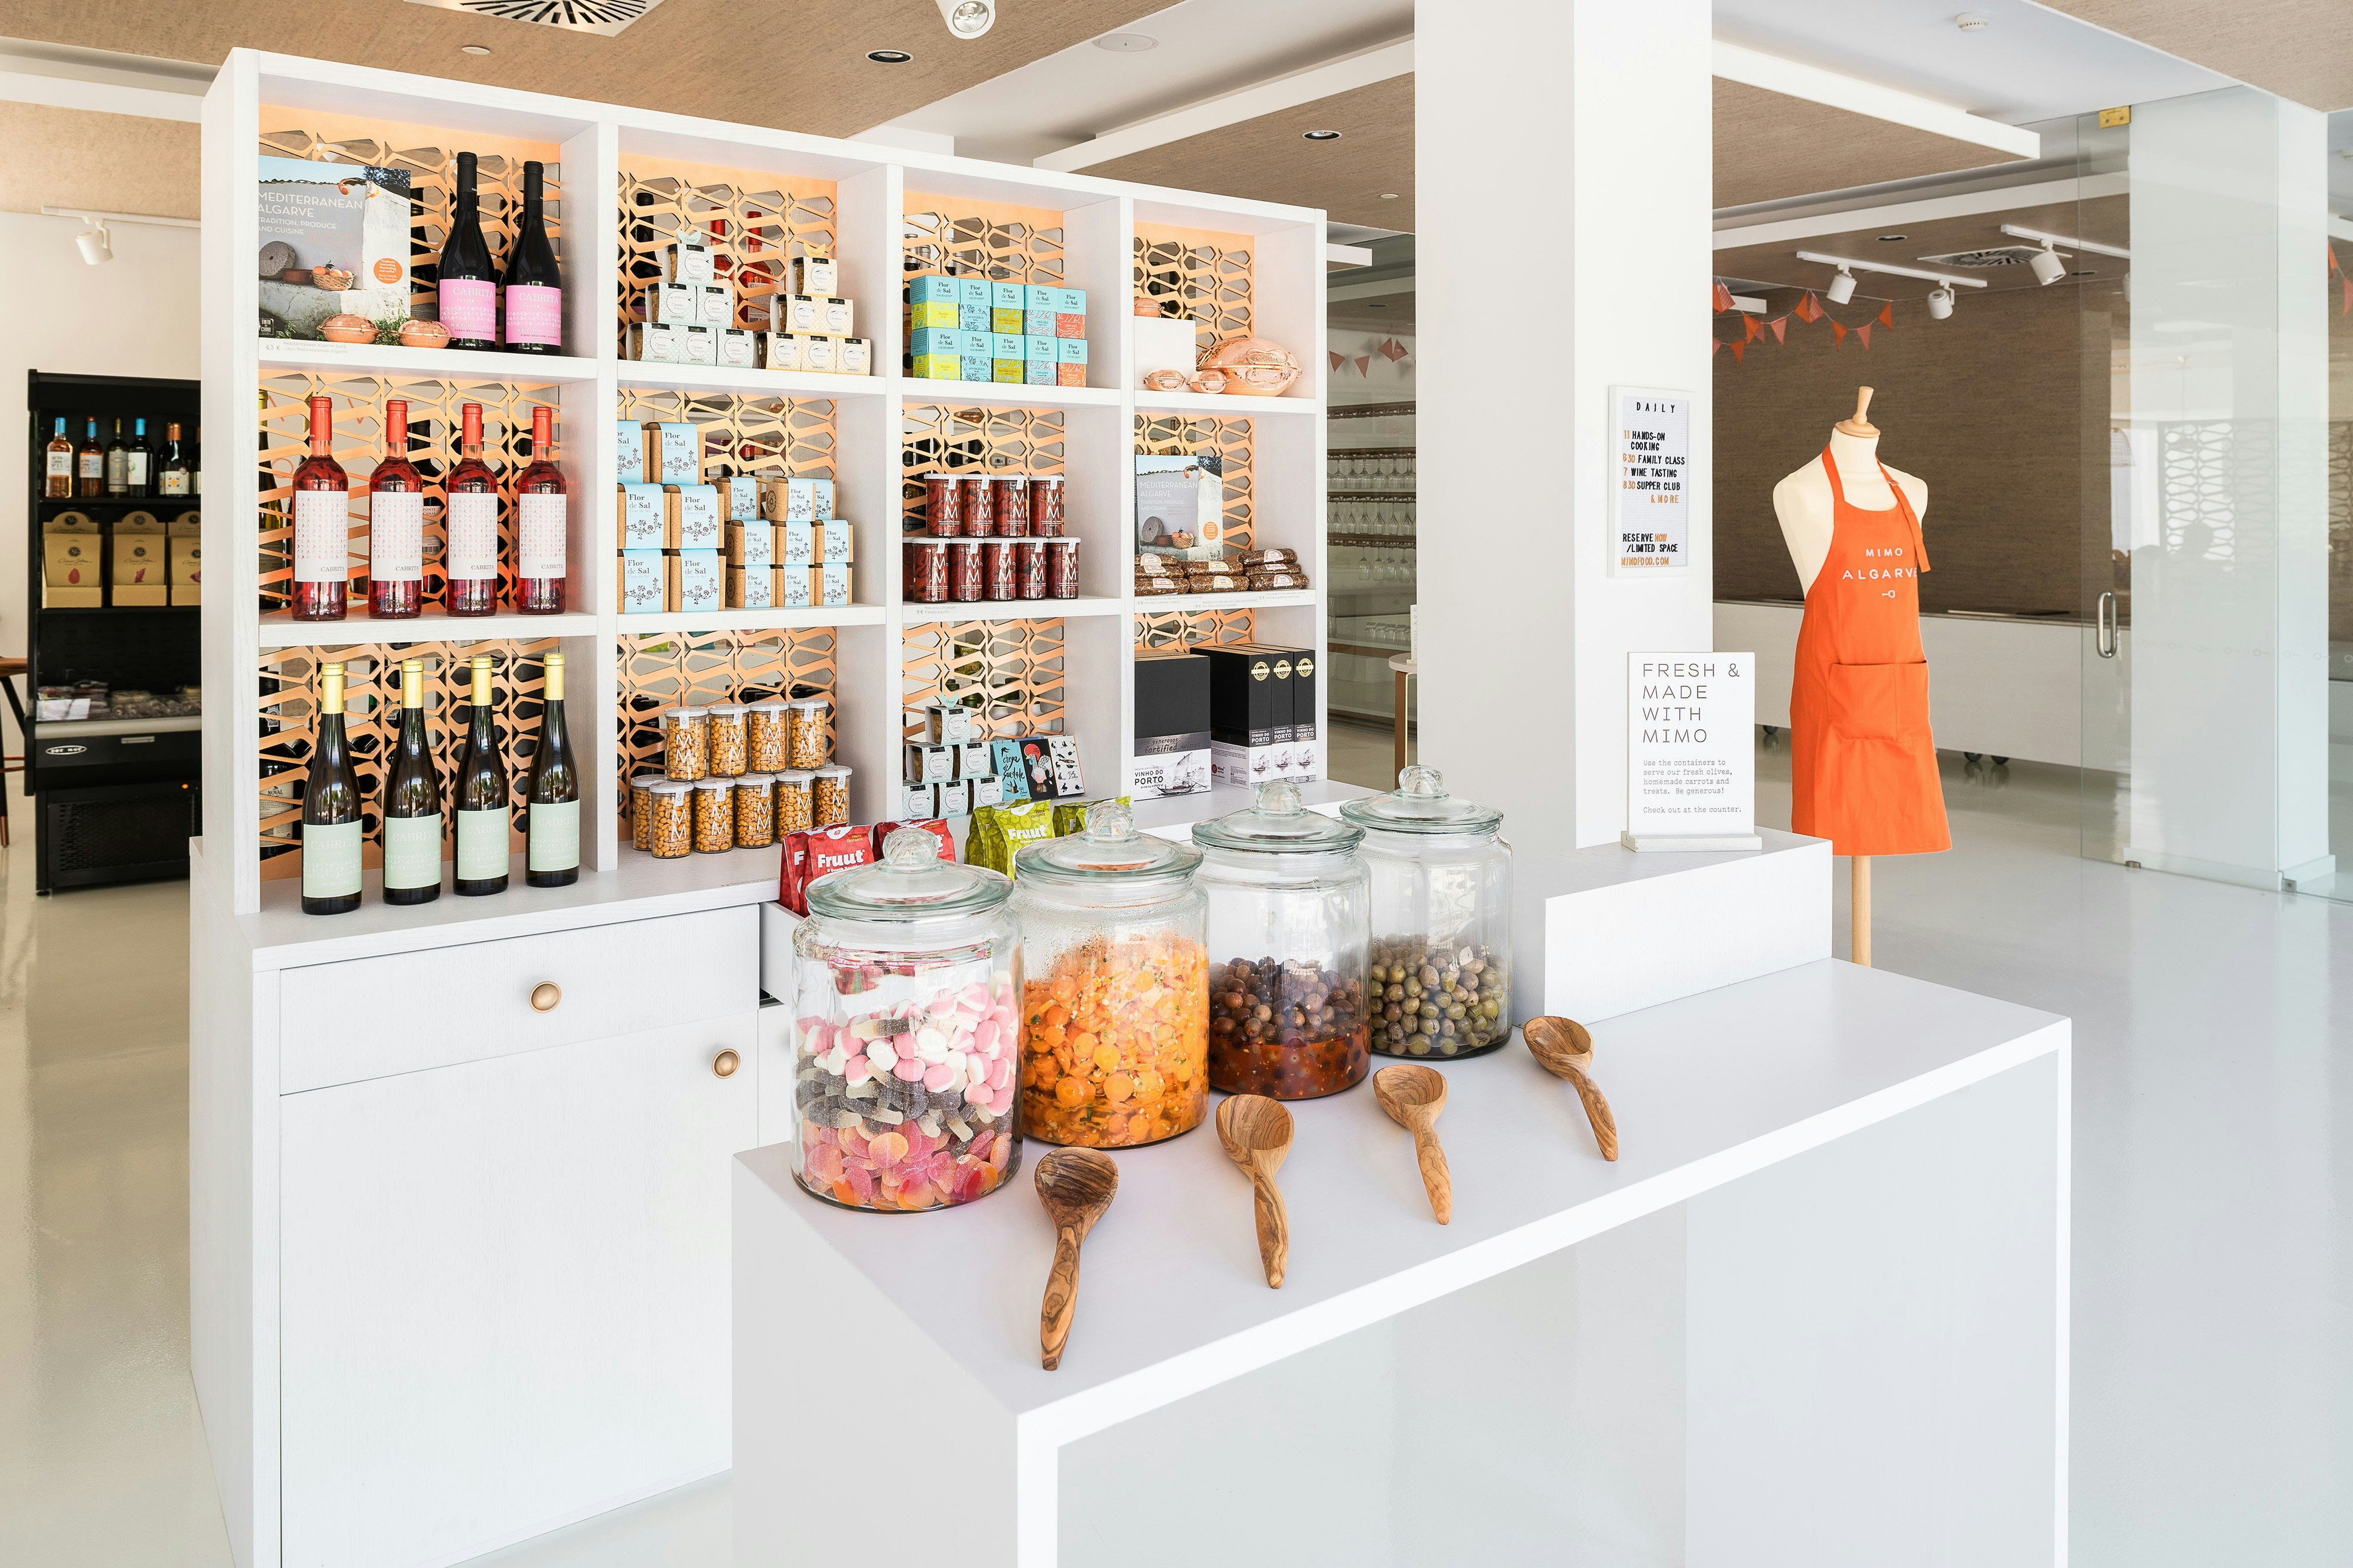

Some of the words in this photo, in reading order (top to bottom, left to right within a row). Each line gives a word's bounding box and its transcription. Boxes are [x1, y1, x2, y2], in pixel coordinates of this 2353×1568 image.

[259, 192, 363, 210] MEDITERRANEAN
[301, 221, 336, 229] PRODUCE
[274, 227, 304, 235] CUISINE
[453, 286, 494, 298] CABRITA
[519, 293, 558, 304] CABRITA
[1637, 402, 1675, 413] DAILY
[1632, 431, 1665, 441] HANDS-ON
[1631, 442, 1659, 451] COOKING
[1638, 455, 1662, 465] FAMILY
[1665, 456, 1685, 465] CLASS
[1624, 467, 1628, 476] 7
[1631, 468, 1647, 476] WINE
[1651, 469, 1677, 478] TASTING
[1637, 481, 1661, 491] SUPPER
[1664, 482, 1680, 491] CLUB
[1651, 495, 1655, 503] &
[1658, 495, 1679, 503] MORE
[1622, 533, 1654, 542] RESERVE
[1654, 533, 1667, 542] NOW
[1659, 543, 1678, 552] SPACE
[1866, 548, 1903, 557] MIMO
[1621, 556, 1669, 566] MIMOFOOD.COM
[1842, 568, 1918, 580] ALGARVE
[1643, 663, 1715, 677] FRESH
[1728, 663, 1740, 677] &
[1643, 685, 1707, 699] MADE
[1642, 707, 1701, 721] WITH
[1643, 729, 1707, 743] MIMO
[1145, 743, 1177, 753] fortified
[1135, 776, 1163, 785] PORTO
[1687, 788, 1724, 796] generous!
[538, 816, 578, 827] CABRITA
[466, 822, 508, 835] CABRITA
[392, 830, 438, 842] CABRITA
[311, 838, 358, 850] CABRITA
